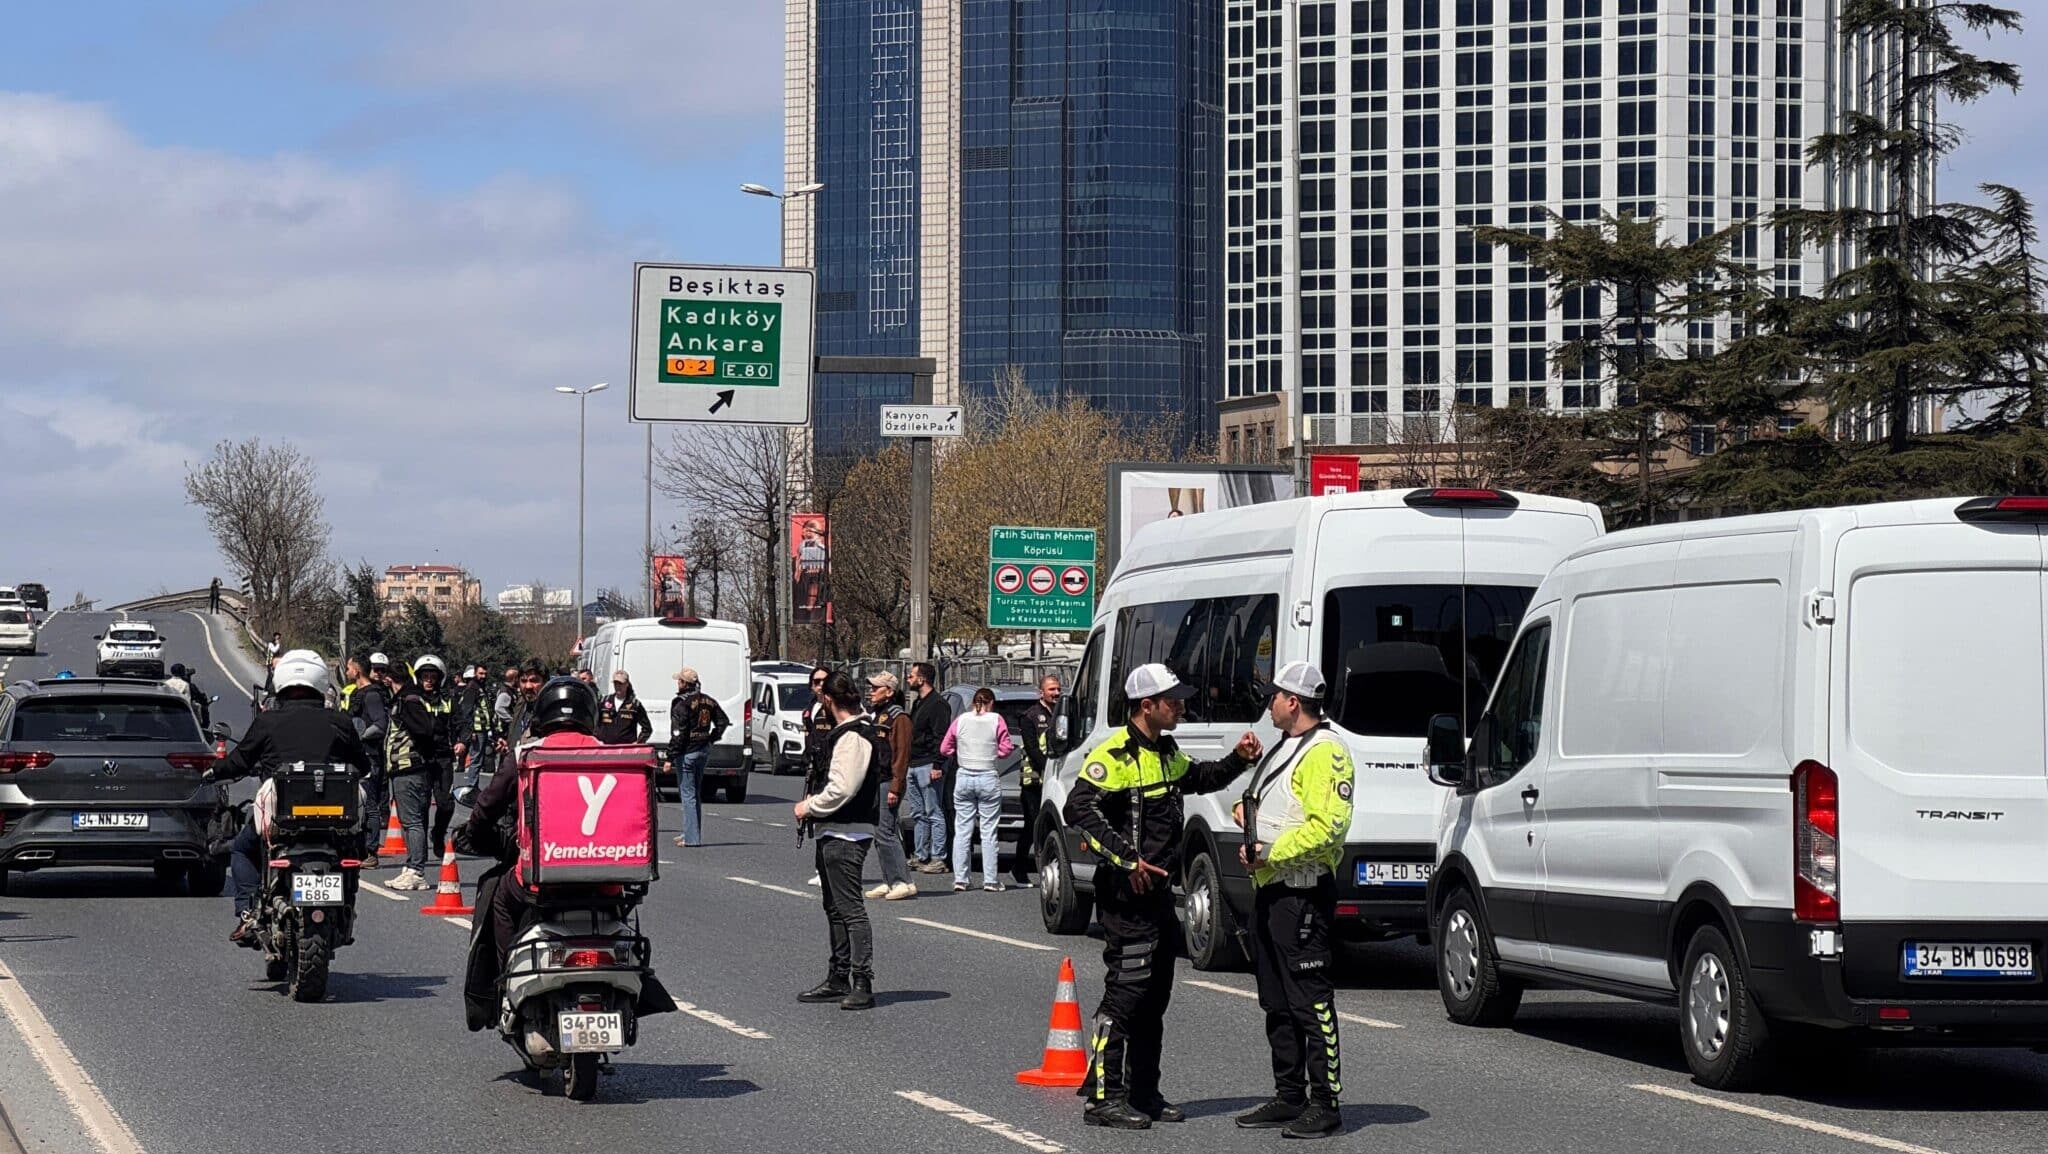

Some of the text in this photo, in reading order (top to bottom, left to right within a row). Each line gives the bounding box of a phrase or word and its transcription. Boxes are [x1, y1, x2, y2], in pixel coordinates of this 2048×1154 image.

[669, 276, 785, 297] Beşiktaş
[667, 306, 776, 331] Kadıköy
[667, 332, 764, 352] Ankara
[727, 365, 768, 377] E.80
[885, 411, 929, 421] Kanyon
[994, 529, 1094, 542] Fatih Sultan Mehmet
[1024, 545, 1063, 556] Köprüsü
[1011, 606, 1037, 614] Servis
[1018, 615, 1053, 623] Karavan
[577, 773, 618, 836] Y
[80, 813, 145, 825] 34 NNJ 527
[1916, 809, 2005, 821] TRANSIT
[543, 841, 648, 861] Yemeksepeti
[1368, 864, 1384, 879] 34
[1392, 864, 1408, 879] ED
[295, 876, 340, 888] 34 MGZ
[305, 889, 330, 901] 686
[1919, 945, 1942, 967] 34
[1952, 945, 1976, 967] BM
[1983, 946, 2029, 968] 0698
[578, 1030, 610, 1044] 899
